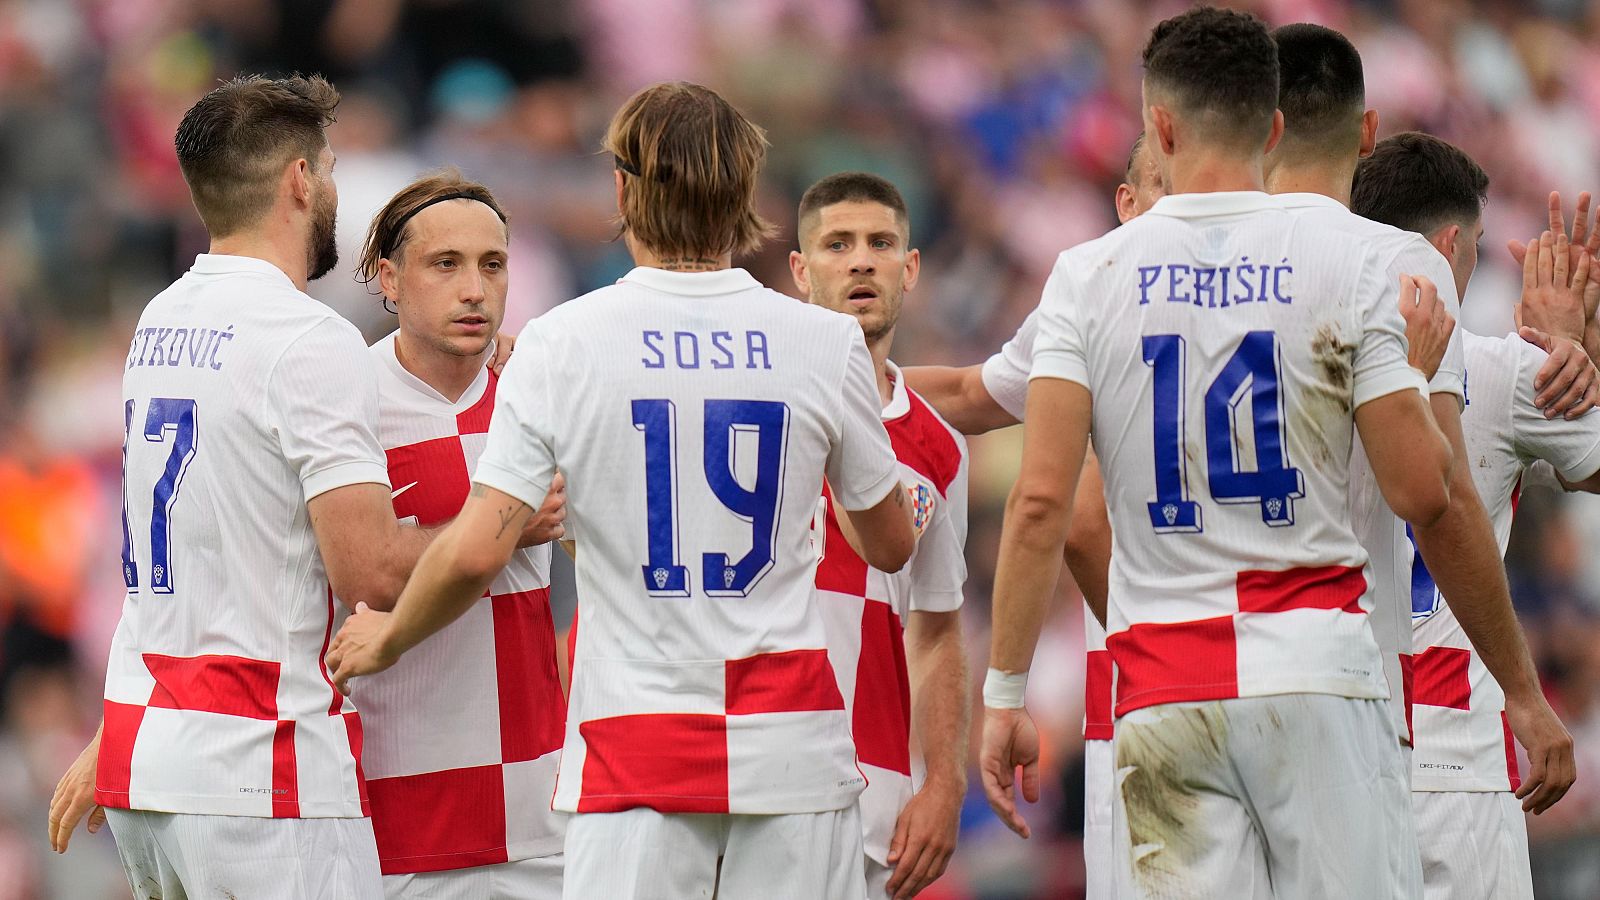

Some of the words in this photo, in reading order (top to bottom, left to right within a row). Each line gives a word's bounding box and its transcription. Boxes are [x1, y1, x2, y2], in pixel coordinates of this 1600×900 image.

[1138, 256, 1293, 308] PERIŠIĆ
[641, 330, 772, 369] SOSA
[1142, 330, 1305, 534] 14
[631, 398, 791, 598] 19
